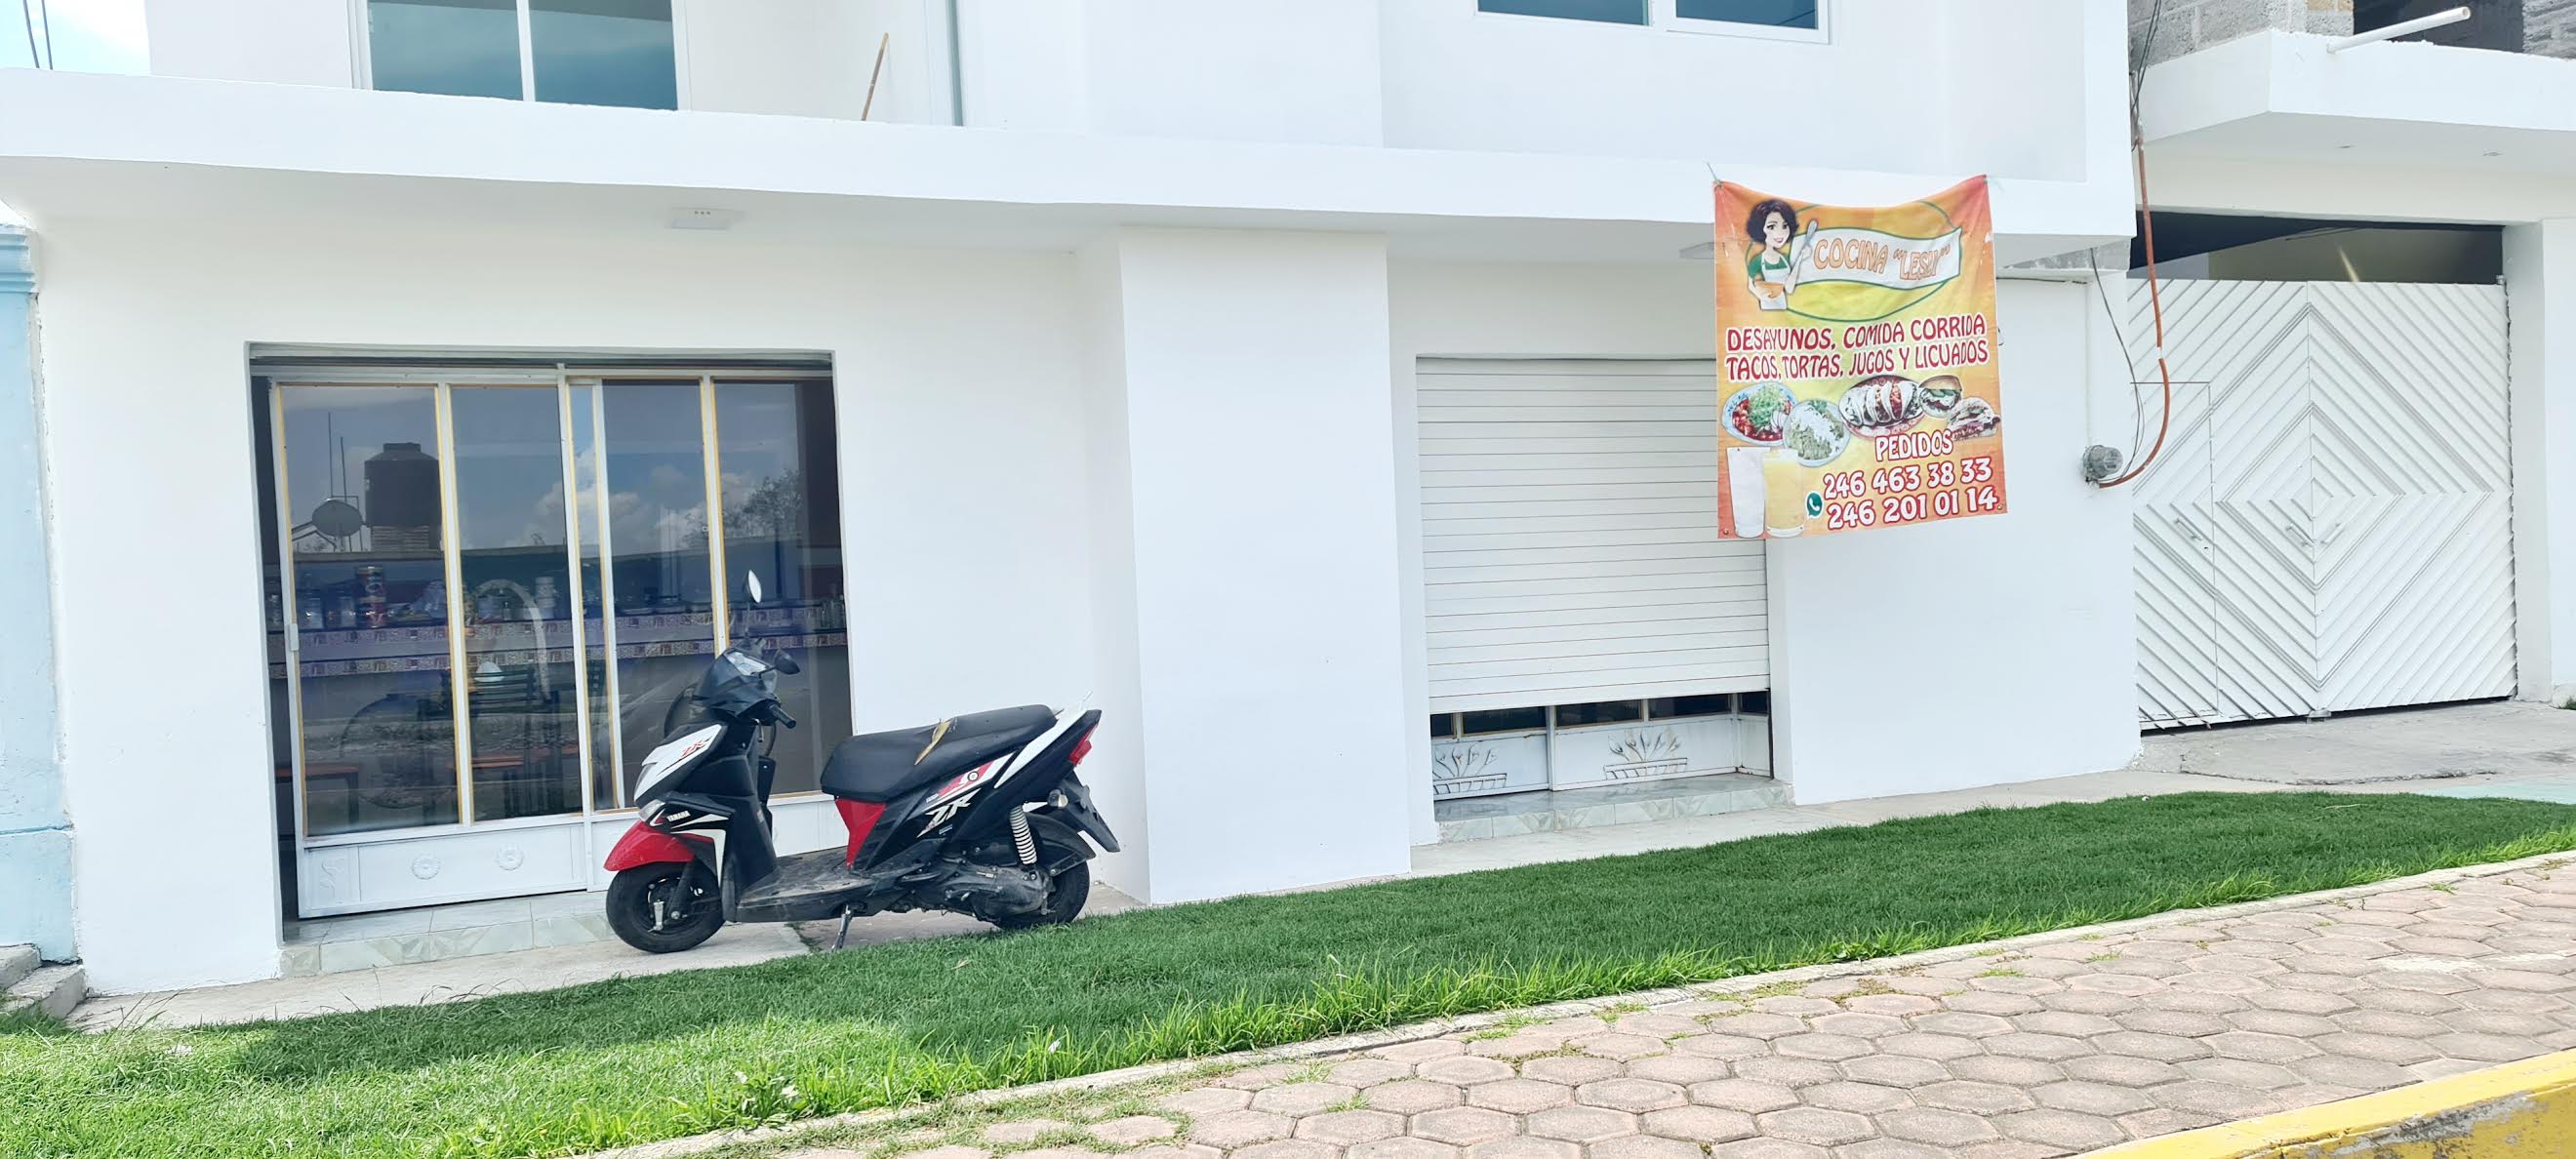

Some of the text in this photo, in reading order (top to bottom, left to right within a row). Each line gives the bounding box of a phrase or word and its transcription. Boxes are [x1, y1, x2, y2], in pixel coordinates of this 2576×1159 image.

[1814, 238, 1888, 273] COCINA
[1727, 314, 1985, 350] DESAYUNOS, COMIDA CORRIDA
[1849, 349, 1894, 376] JUGOS
[1899, 347, 1910, 370] Y
[1915, 340, 1988, 368] LICUADOS
[1875, 429, 1953, 461] PEDIDOS
[1824, 457, 1992, 500] 246 463 38 33
[1828, 485, 1997, 530] 246 201 01 14
